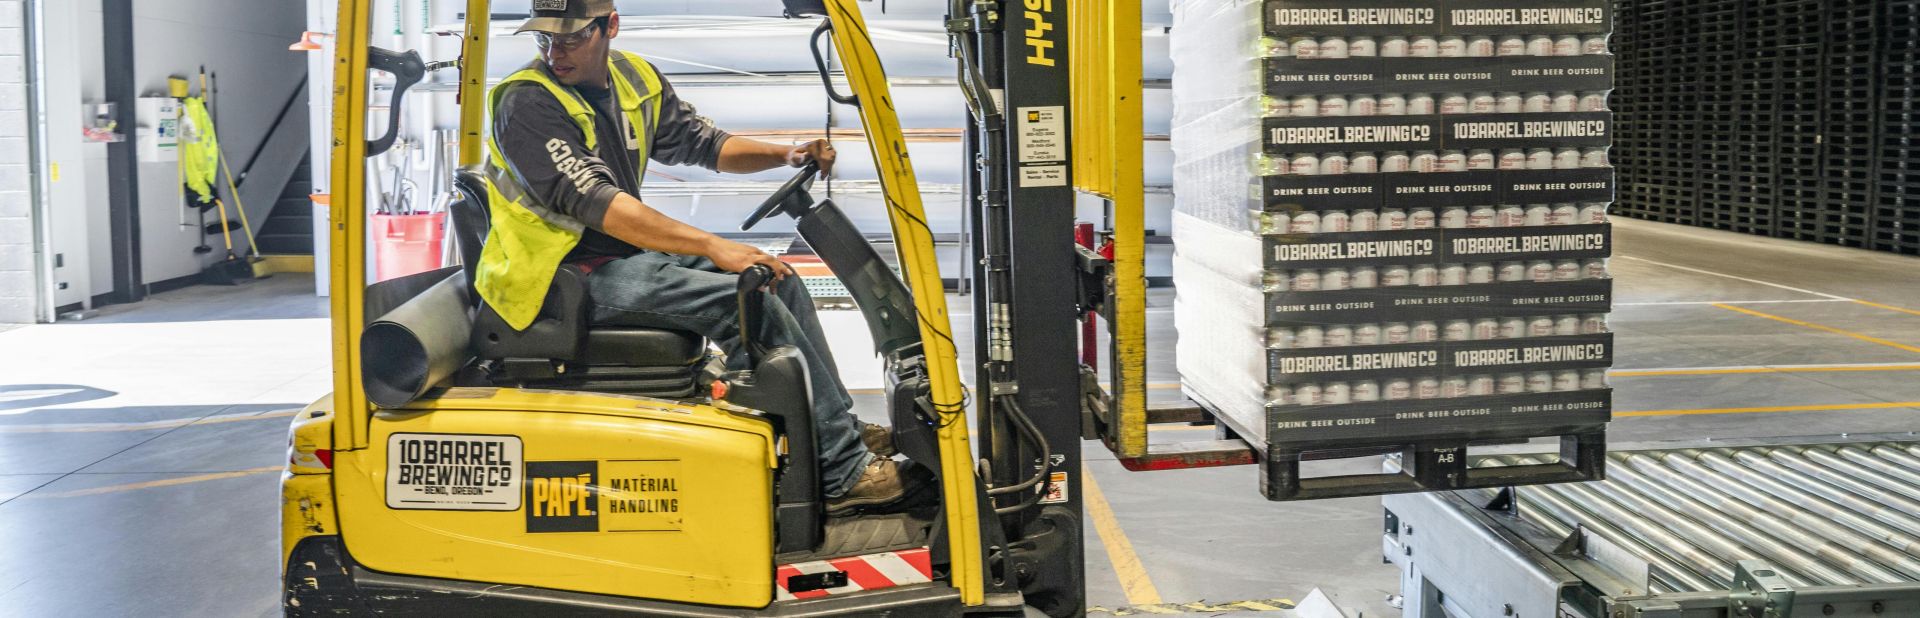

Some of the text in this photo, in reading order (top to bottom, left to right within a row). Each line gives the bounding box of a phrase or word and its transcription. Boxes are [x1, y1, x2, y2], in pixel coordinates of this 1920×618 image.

[1348, 8, 1413, 25] BREWING
[1522, 8, 1583, 25] BREWING
[1274, 73, 1373, 82] DRINK BEER OUTSIDE
[1396, 72, 1491, 81] DRINK BEER OUTSIDE
[1512, 67, 1603, 76] DRINK BEER OUTSIDE
[1345, 126, 1410, 142] BREWING
[1523, 121, 1585, 138] BREWING
[1274, 186, 1372, 196] DRINK BEER OUTSIDE
[1396, 184, 1491, 194] DRINK BEER OUTSIDE
[1514, 181, 1605, 191] DRINK BEER OUTSIDE
[1348, 240, 1412, 259] BREWING
[1522, 235, 1584, 253] BREWING
[1395, 295, 1489, 306] DRINK BEER OUTSIDE
[1513, 294, 1604, 305] DRINK BEER OUTSIDE
[1276, 301, 1373, 313] DRINK BEER OUTSIDE
[1524, 345, 1585, 363] BREWING
[1353, 351, 1416, 370] BREWING
[1512, 401, 1602, 414] DRINK BEER OUTSIDE
[1396, 408, 1490, 420] DRINK BEER OUTSIDE
[1278, 417, 1375, 429] DRINK BEER OUTSIDE
[399, 439, 511, 466] 10 BARREL
[1438, 453, 1455, 463] A-B
[398, 465, 486, 486] BREWING
[451, 486, 483, 496] OREGON
[610, 478, 678, 492] MATERIAL
[610, 498, 679, 513] HANDLING
